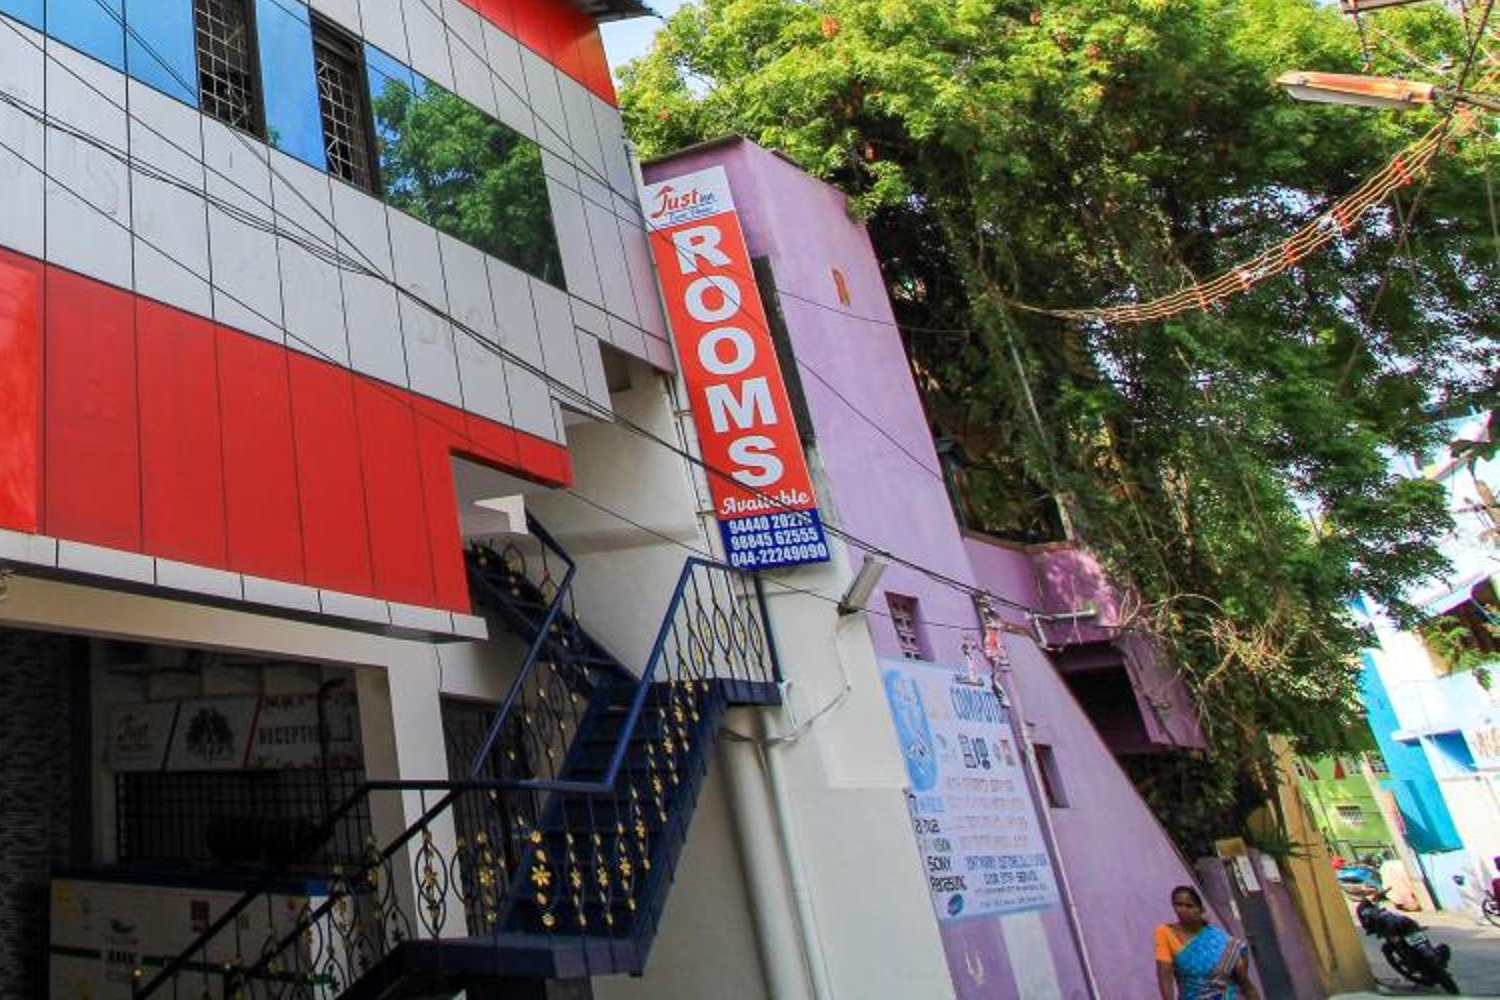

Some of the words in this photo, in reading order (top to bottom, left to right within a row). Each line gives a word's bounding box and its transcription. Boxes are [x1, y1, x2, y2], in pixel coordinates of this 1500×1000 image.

[651, 187, 698, 218] Just
[672, 224, 784, 487] ROOMS
[729, 515, 770, 534] 94440
[774, 527, 819, 545] 62555
